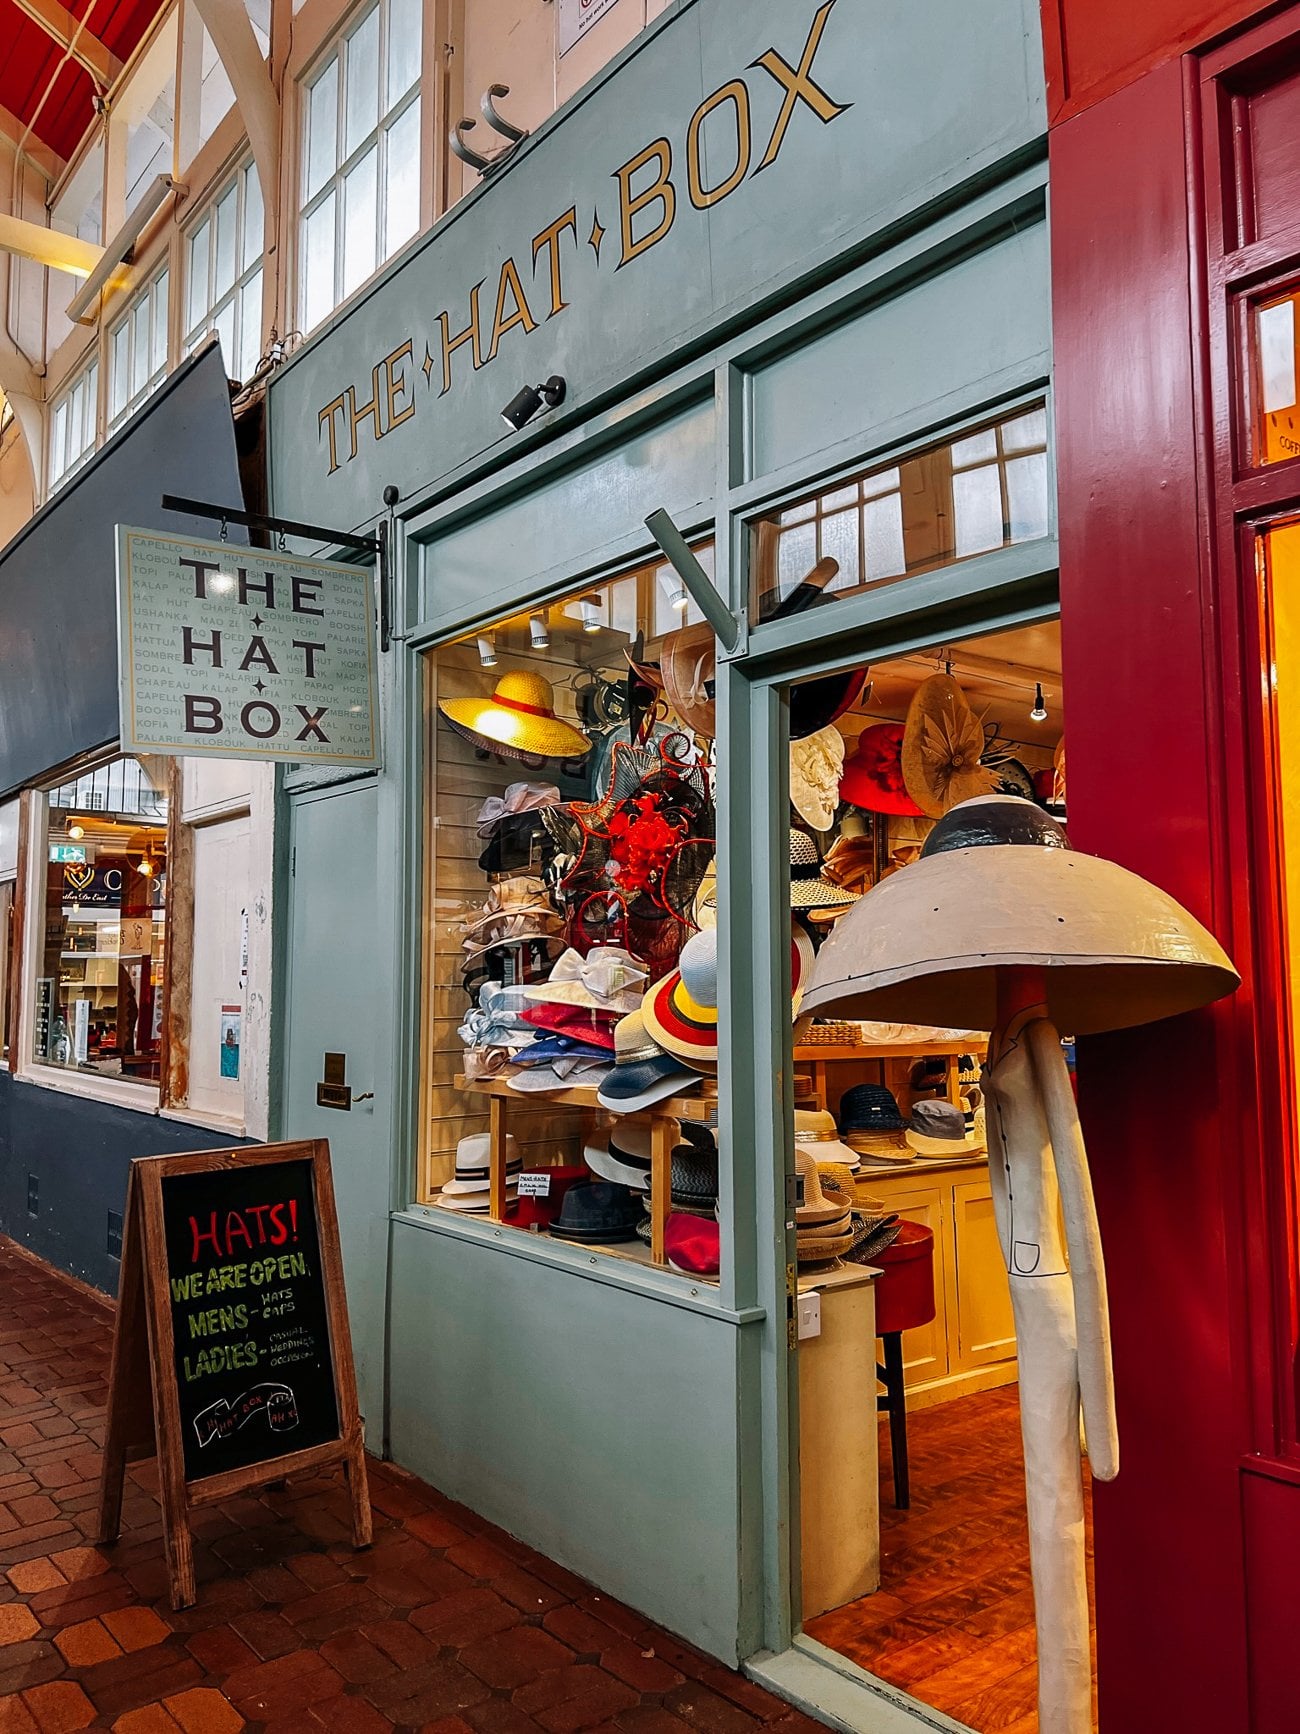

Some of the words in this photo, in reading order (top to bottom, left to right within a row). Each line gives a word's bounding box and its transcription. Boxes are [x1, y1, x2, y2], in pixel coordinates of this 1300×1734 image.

[318, 338, 416, 477] THE
[433, 204, 578, 399] HAT
[610, 0, 855, 273] BOX
[1280, 435, 1300, 454] COFF
[132, 538, 182, 553] CAPELLO
[193, 548, 213, 558] HAT
[224, 553, 244, 563] HUT
[256, 558, 301, 572] CHAPEAU
[311, 568, 363, 582] SOMBRERO
[133, 580, 168, 591] KALAP
[133, 566, 157, 576] TOPI
[335, 597, 363, 607] SAPKA
[179, 556, 325, 618] THE
[333, 584, 364, 595] DODAL
[134, 594, 153, 603] HAT
[167, 598, 189, 608] HUT
[201, 603, 251, 616] CHAPEAU
[262, 612, 319, 625] SOMBRERO
[329, 621, 365, 632] BOOSHI
[134, 622, 160, 631] HATT
[337, 647, 366, 656] SAPKA
[294, 629, 316, 637] TOPI
[327, 633, 366, 644] PALARIE
[135, 636, 175, 647] HATTUA
[341, 660, 366, 669] KOFIA
[182, 626, 327, 679] HAT
[135, 664, 174, 674] DODAL
[184, 669, 208, 677] TOPI
[270, 677, 294, 686] HATT
[136, 678, 190, 689] CHAPEAU
[202, 684, 238, 693] KALAP
[291, 692, 338, 703] KLOBOUK
[136, 706, 180, 715] BOOSHI
[137, 720, 168, 728] KOFIA
[183, 694, 331, 744] BOX
[137, 734, 183, 743] PALARIE
[194, 738, 245, 747] KLOBOUK
[257, 742, 289, 750] HATTU
[300, 745, 343, 754] CAPELLO
[189, 1200, 299, 1263] HATS!
[171, 1272, 203, 1302] WE
[206, 1263, 247, 1294] ARE
[261, 1288, 293, 1306] HATS
[262, 1302, 295, 1318] CAPS
